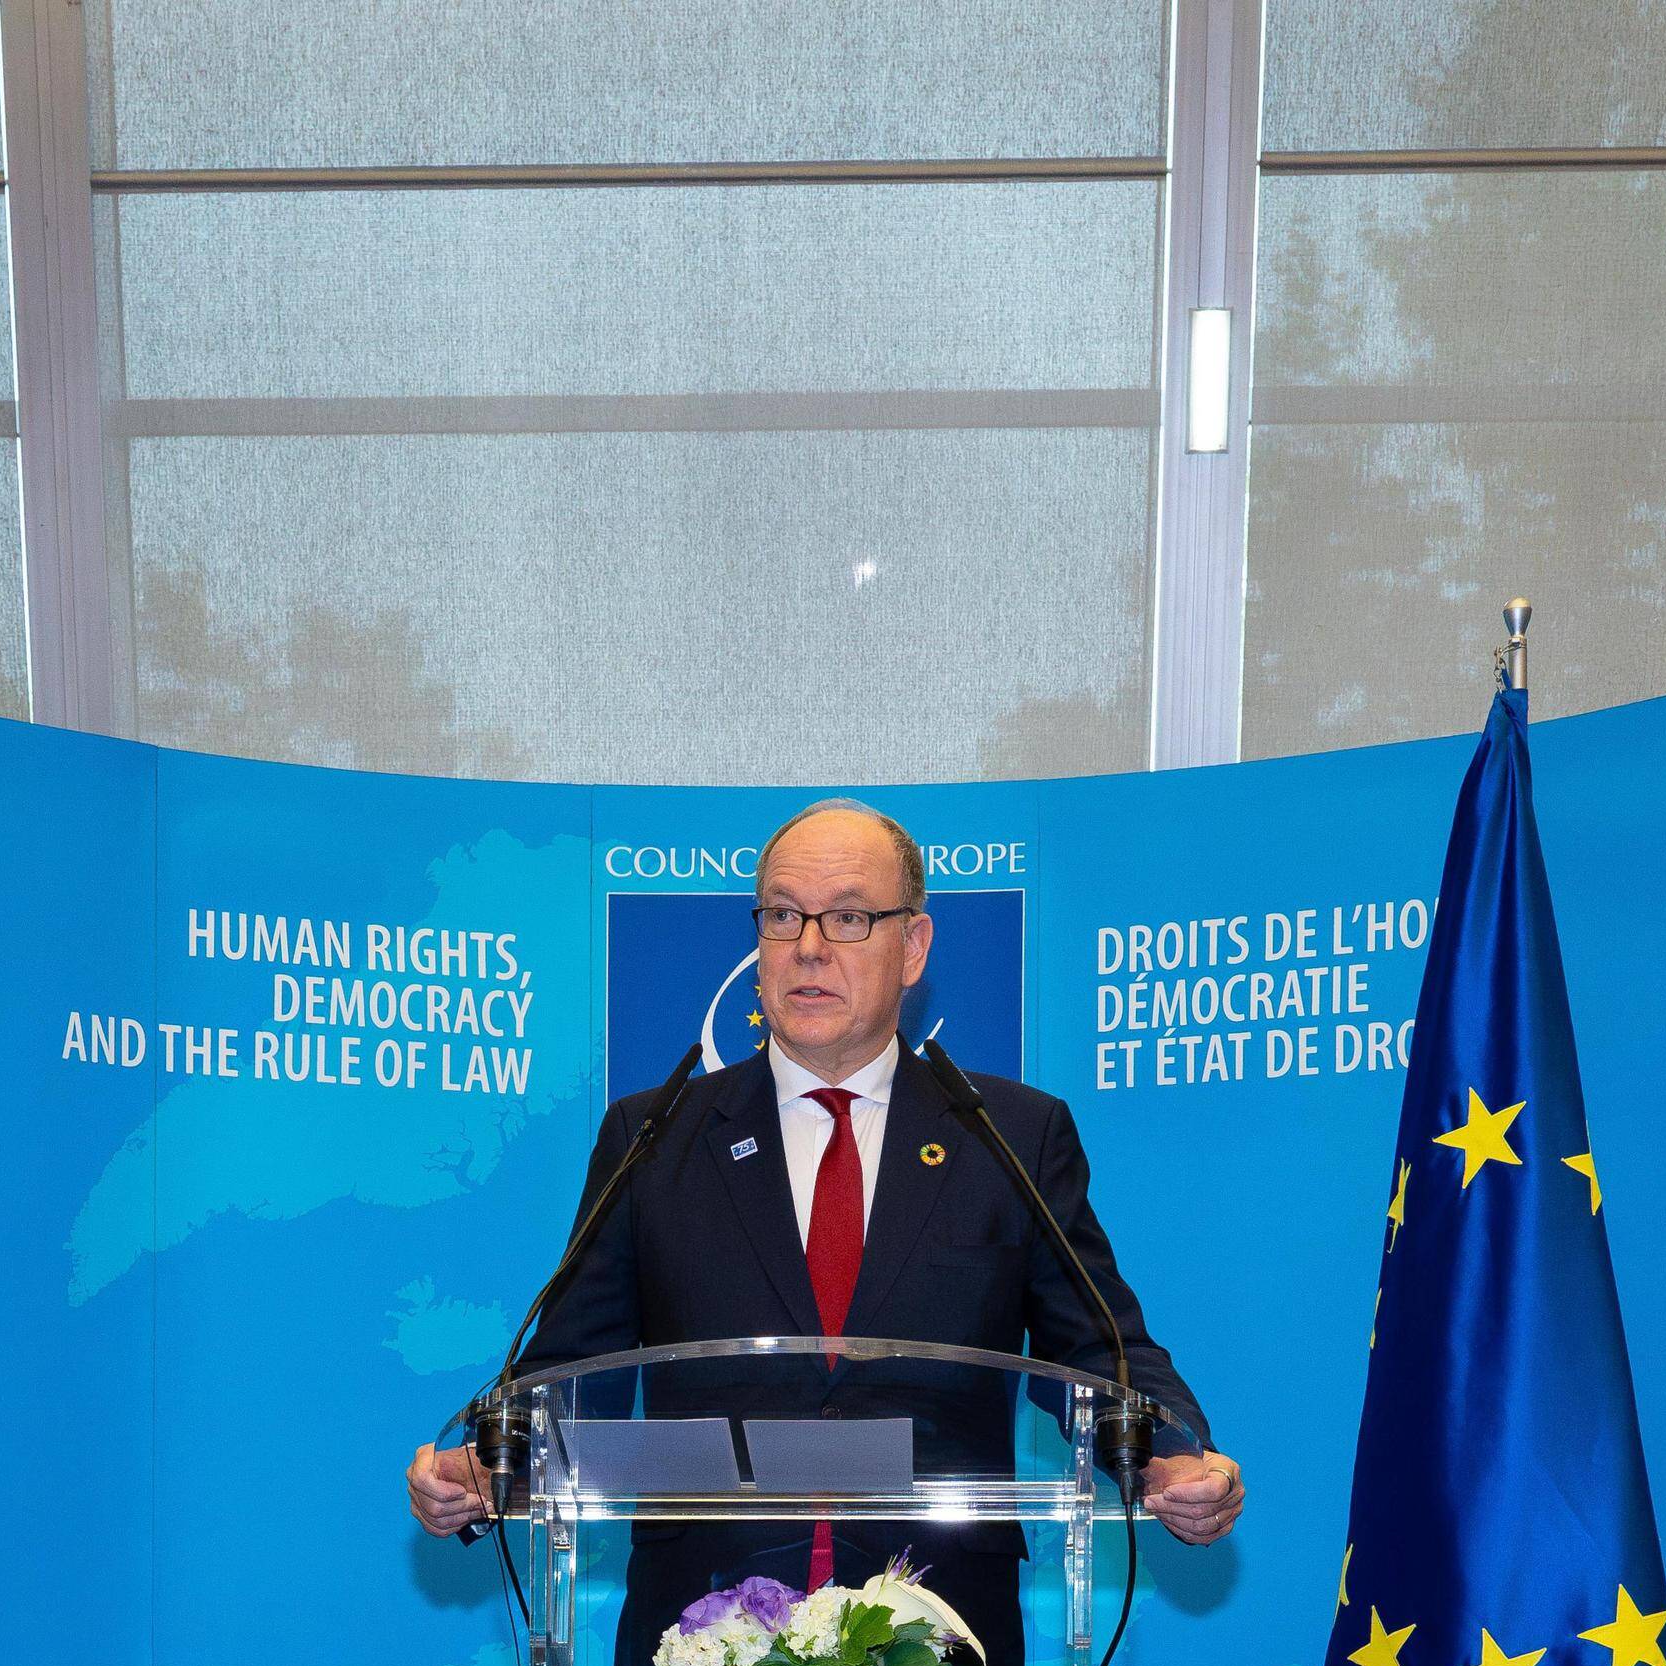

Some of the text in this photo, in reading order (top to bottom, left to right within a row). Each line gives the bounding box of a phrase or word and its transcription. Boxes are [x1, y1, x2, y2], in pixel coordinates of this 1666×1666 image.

[606, 847, 757, 877] COUNC
[189, 909, 531, 988] HUMAN RIGHTS,
[1098, 898, 1439, 974] DROITS DE L'HO
[274, 972, 533, 1037] DEMOCRACY
[1098, 964, 1368, 1032] DÉMOCRATIE
[63, 1012, 532, 1094] AND THE RULE OF LAW
[1098, 1020, 1415, 1089] ET ÉTAT DE DRO
